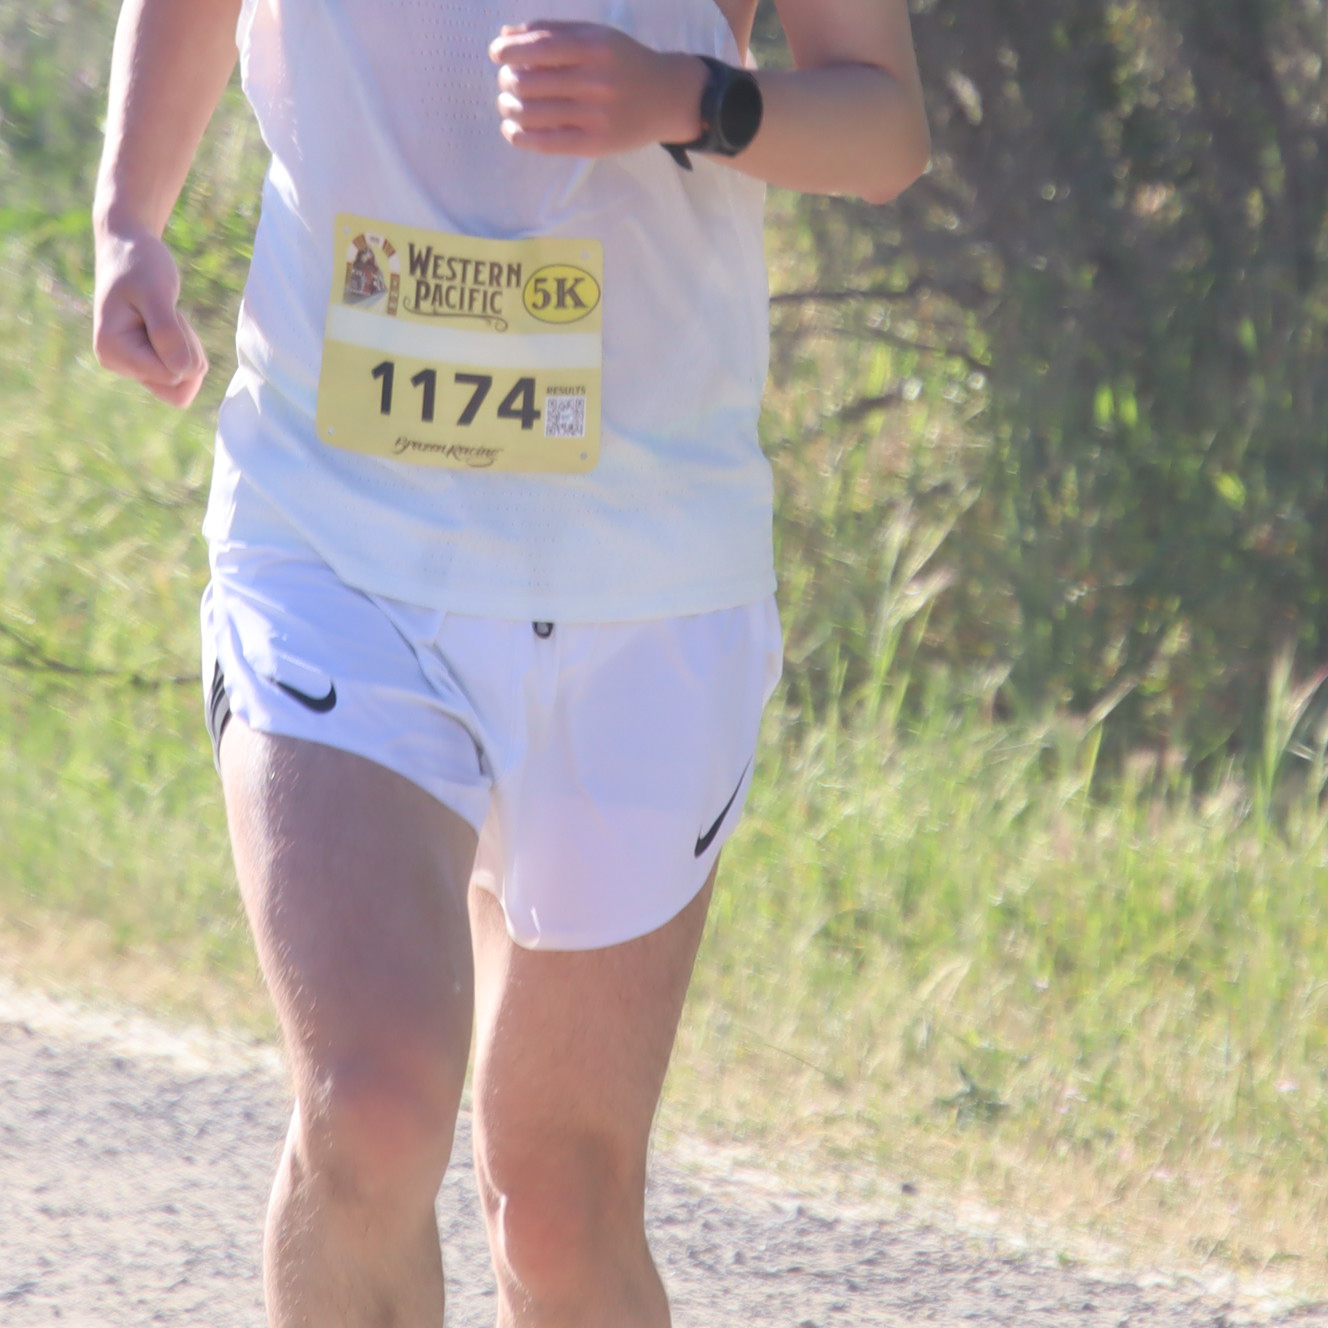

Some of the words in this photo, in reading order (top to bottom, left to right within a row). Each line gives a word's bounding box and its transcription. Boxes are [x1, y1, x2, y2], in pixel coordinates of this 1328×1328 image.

[408, 242, 522, 288] WESTERN
[413, 279, 503, 315] PACIFIC
[531, 277, 589, 311] 5K
[371, 360, 541, 431] 1174
[546, 386, 586, 395] RESULTS
